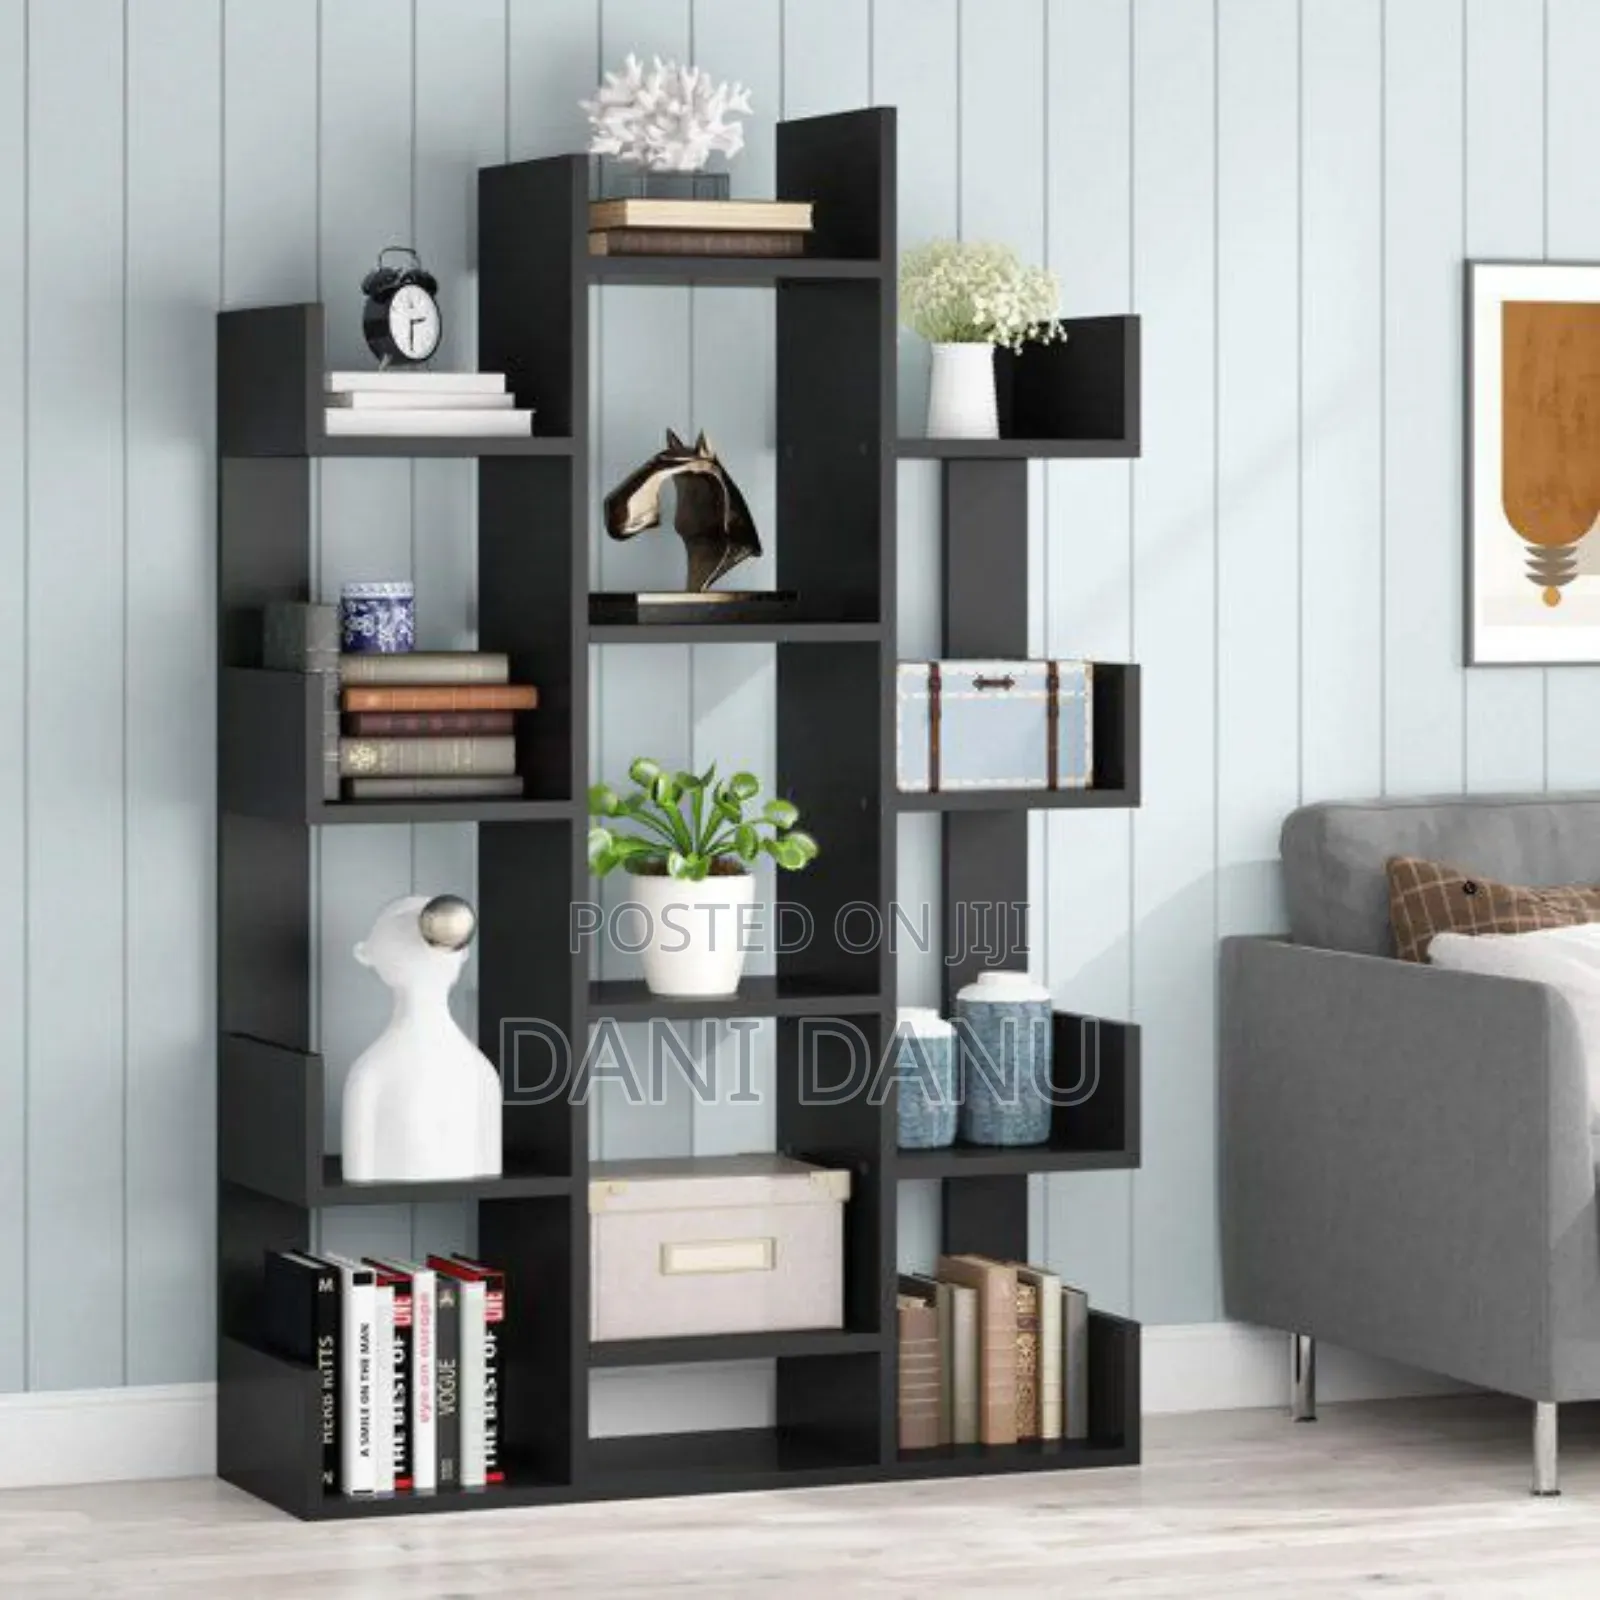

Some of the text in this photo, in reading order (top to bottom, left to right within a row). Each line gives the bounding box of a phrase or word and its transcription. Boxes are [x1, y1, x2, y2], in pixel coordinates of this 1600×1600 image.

[360, 1323, 370, 1457] A SMILE ON THE MAN
[392, 1371, 406, 1426] BEST
[420, 1364, 429, 1387] on
[438, 1359, 455, 1415] VOGUE
[392, 1432, 406, 1473] THE
[483, 1425, 497, 1467] THE
